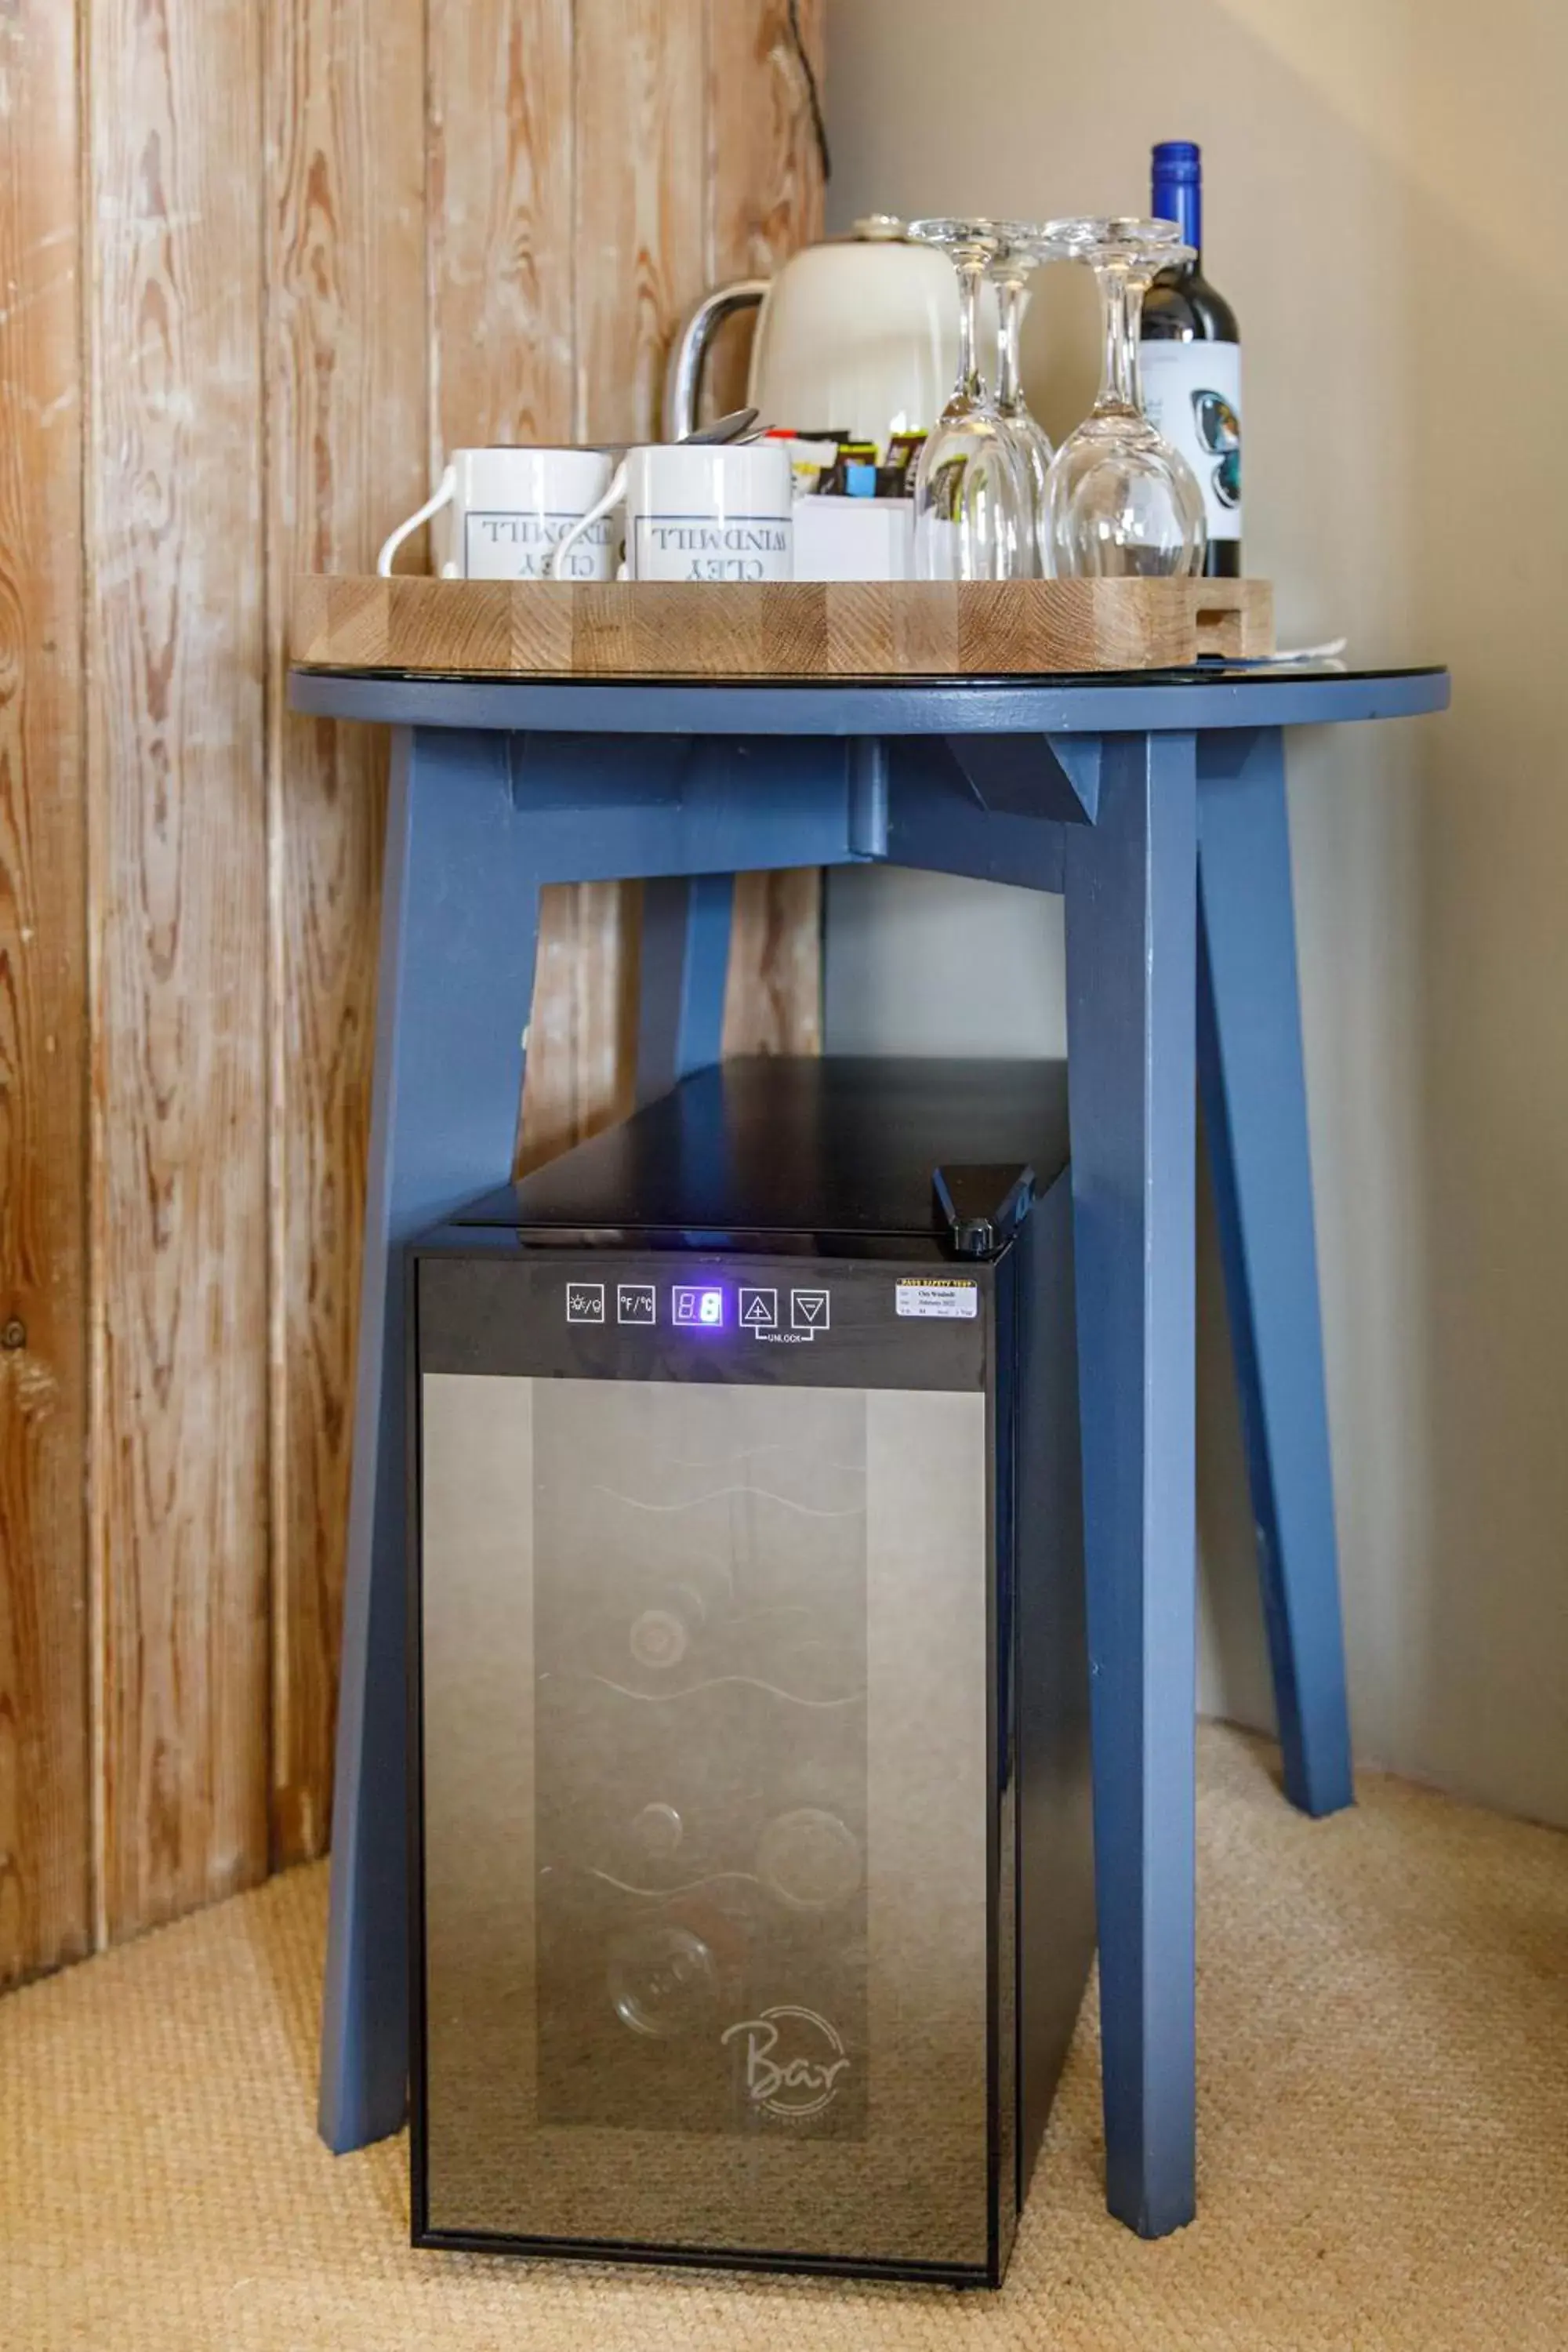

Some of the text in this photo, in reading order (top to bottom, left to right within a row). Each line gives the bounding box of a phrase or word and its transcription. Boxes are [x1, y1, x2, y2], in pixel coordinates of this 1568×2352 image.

[481, 521, 612, 545] INDMILL
[652, 528, 787, 551] WINDMILL
[687, 558, 764, 581] CLEY
[721, 2020, 851, 2099] Bar
